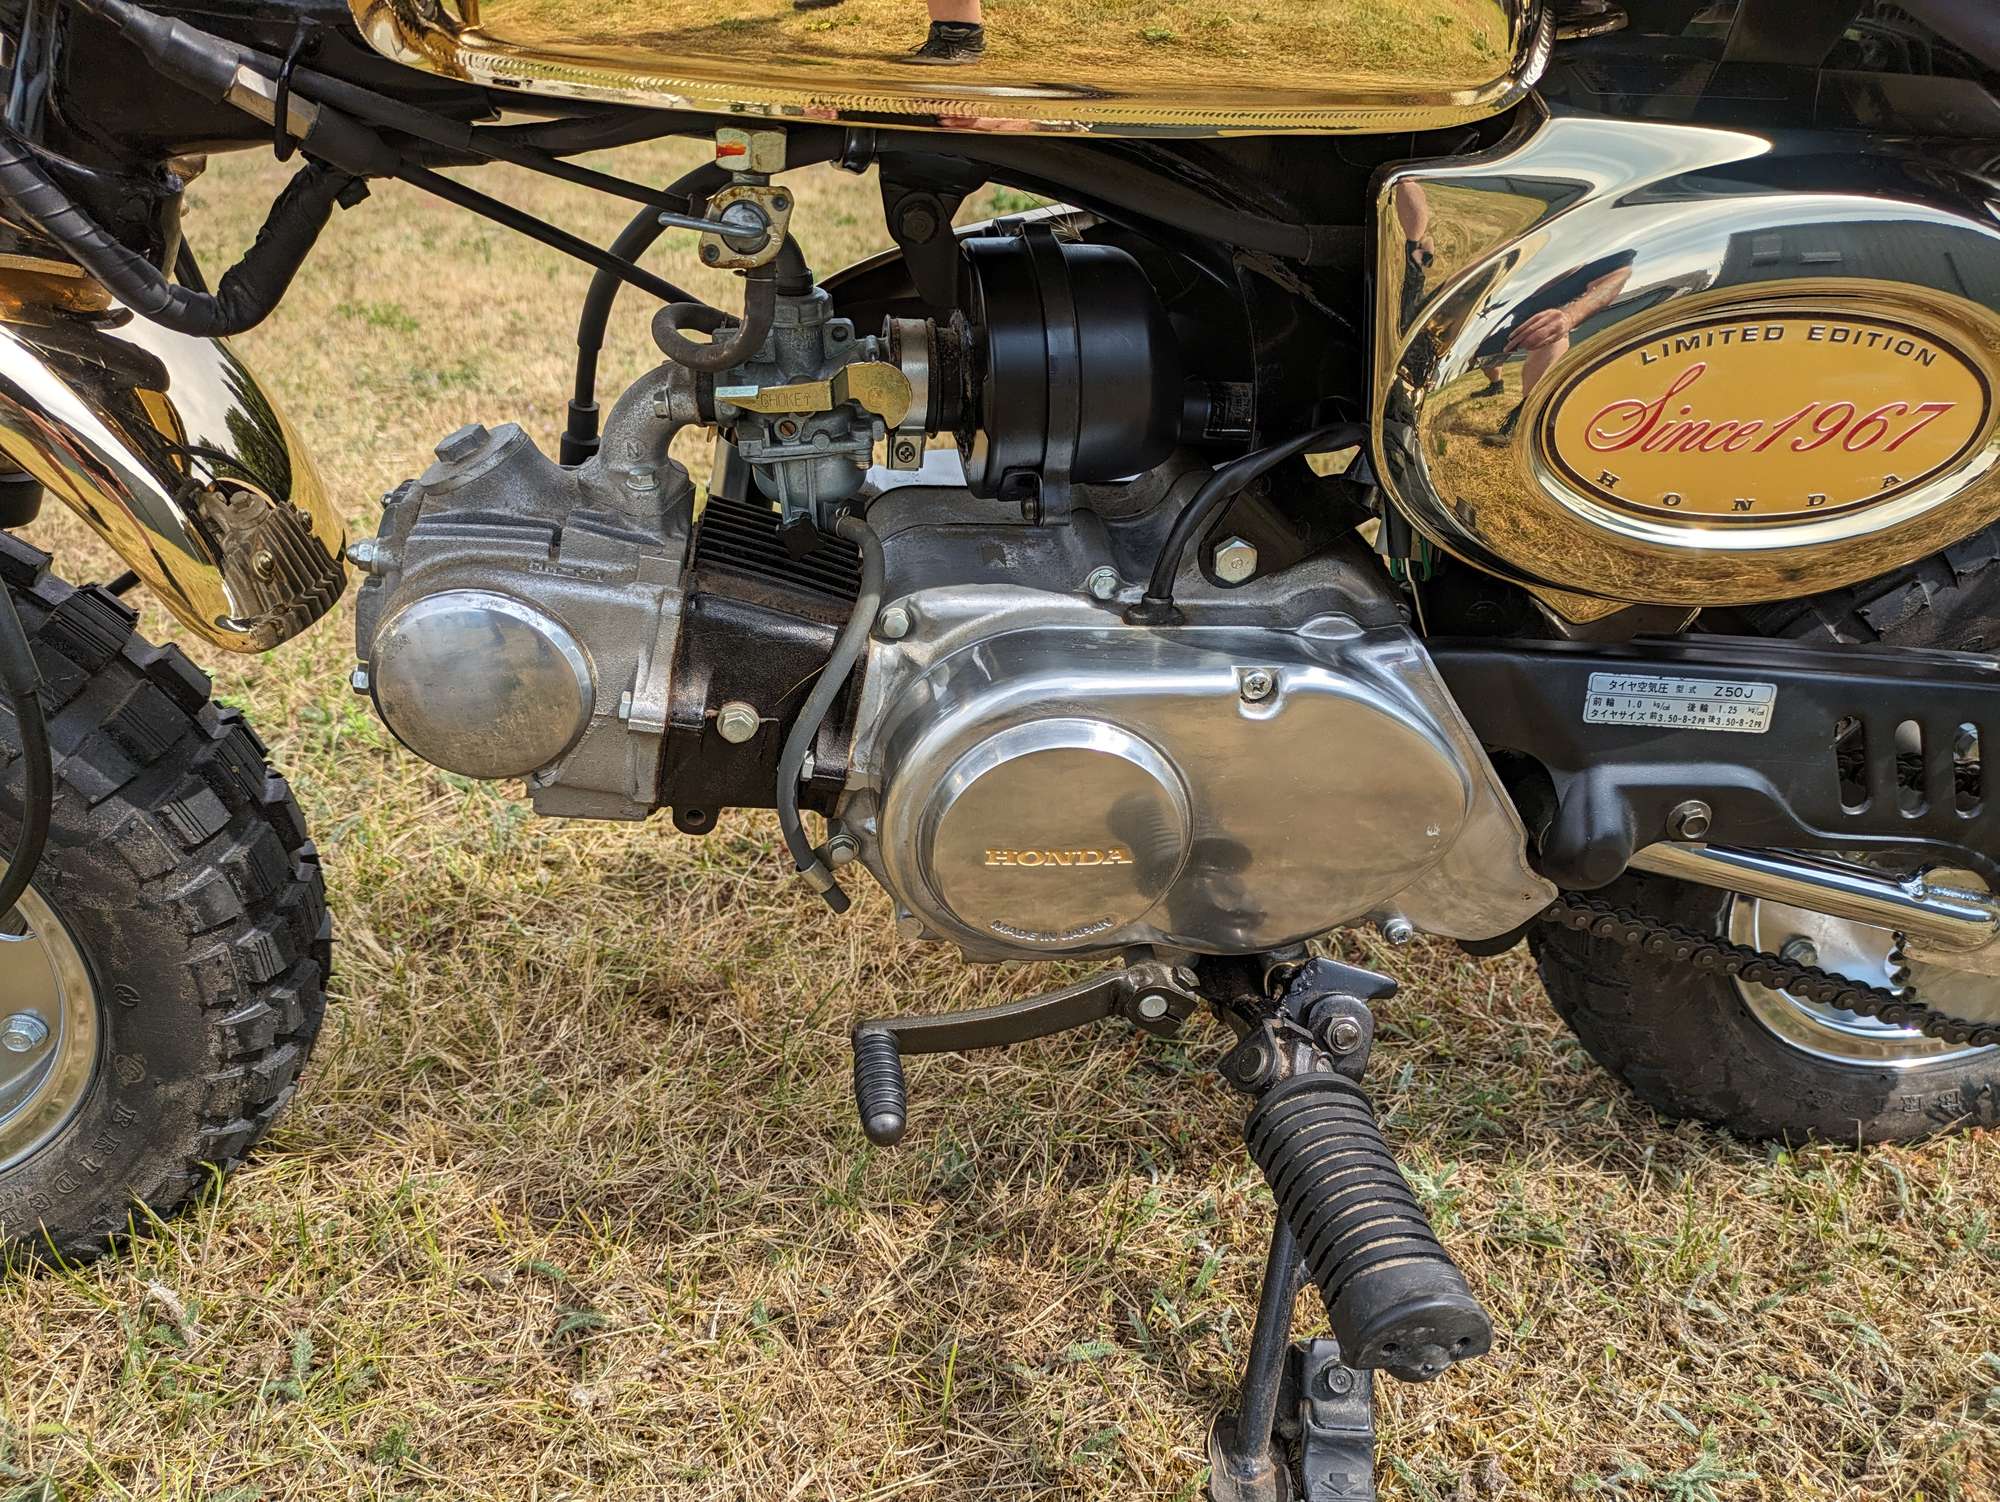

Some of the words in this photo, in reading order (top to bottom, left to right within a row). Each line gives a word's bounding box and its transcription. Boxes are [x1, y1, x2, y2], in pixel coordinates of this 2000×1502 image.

[1640, 325, 1784, 366] LIMITED
[1806, 325, 1938, 368] EDITION
[1596, 469, 1902, 512] HONDA
[1608, 681, 1669, 694] タイヤ空気圧
[1713, 686, 1754, 699] Z50J
[984, 848, 1134, 867] HONDA
